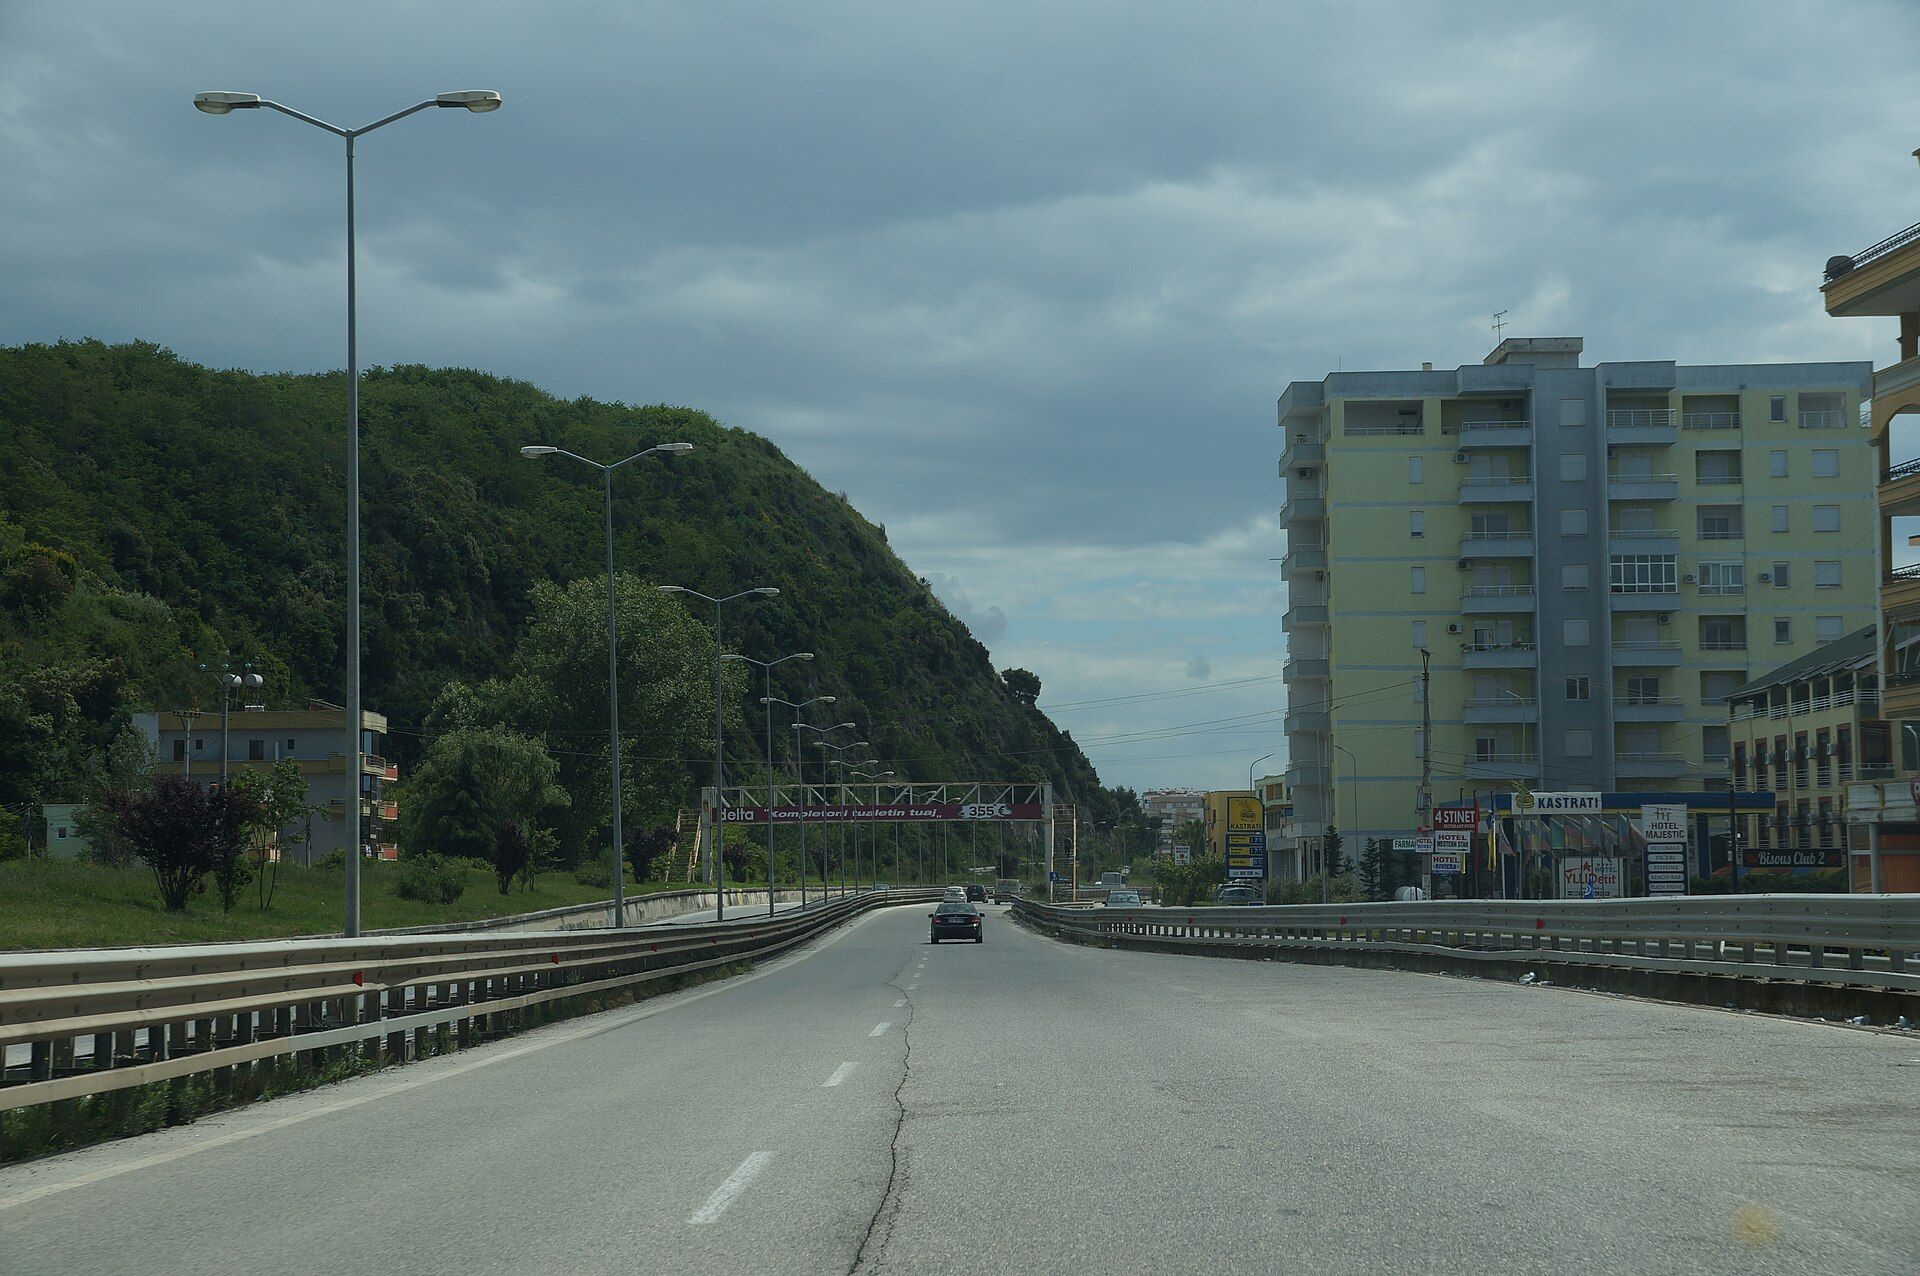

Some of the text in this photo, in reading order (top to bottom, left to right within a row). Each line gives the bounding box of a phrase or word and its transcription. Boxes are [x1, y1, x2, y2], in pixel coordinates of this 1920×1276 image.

[1538, 796, 1599, 809] KASTRATI
[721, 808, 754, 821] delta
[969, 806, 994, 816] 355
[1435, 810, 1475, 823] 4 STINET
[1645, 830, 1685, 839] MAJESTIC
[1394, 840, 1415, 848] FARMA
[1758, 851, 1825, 865] Bisous Club 2
